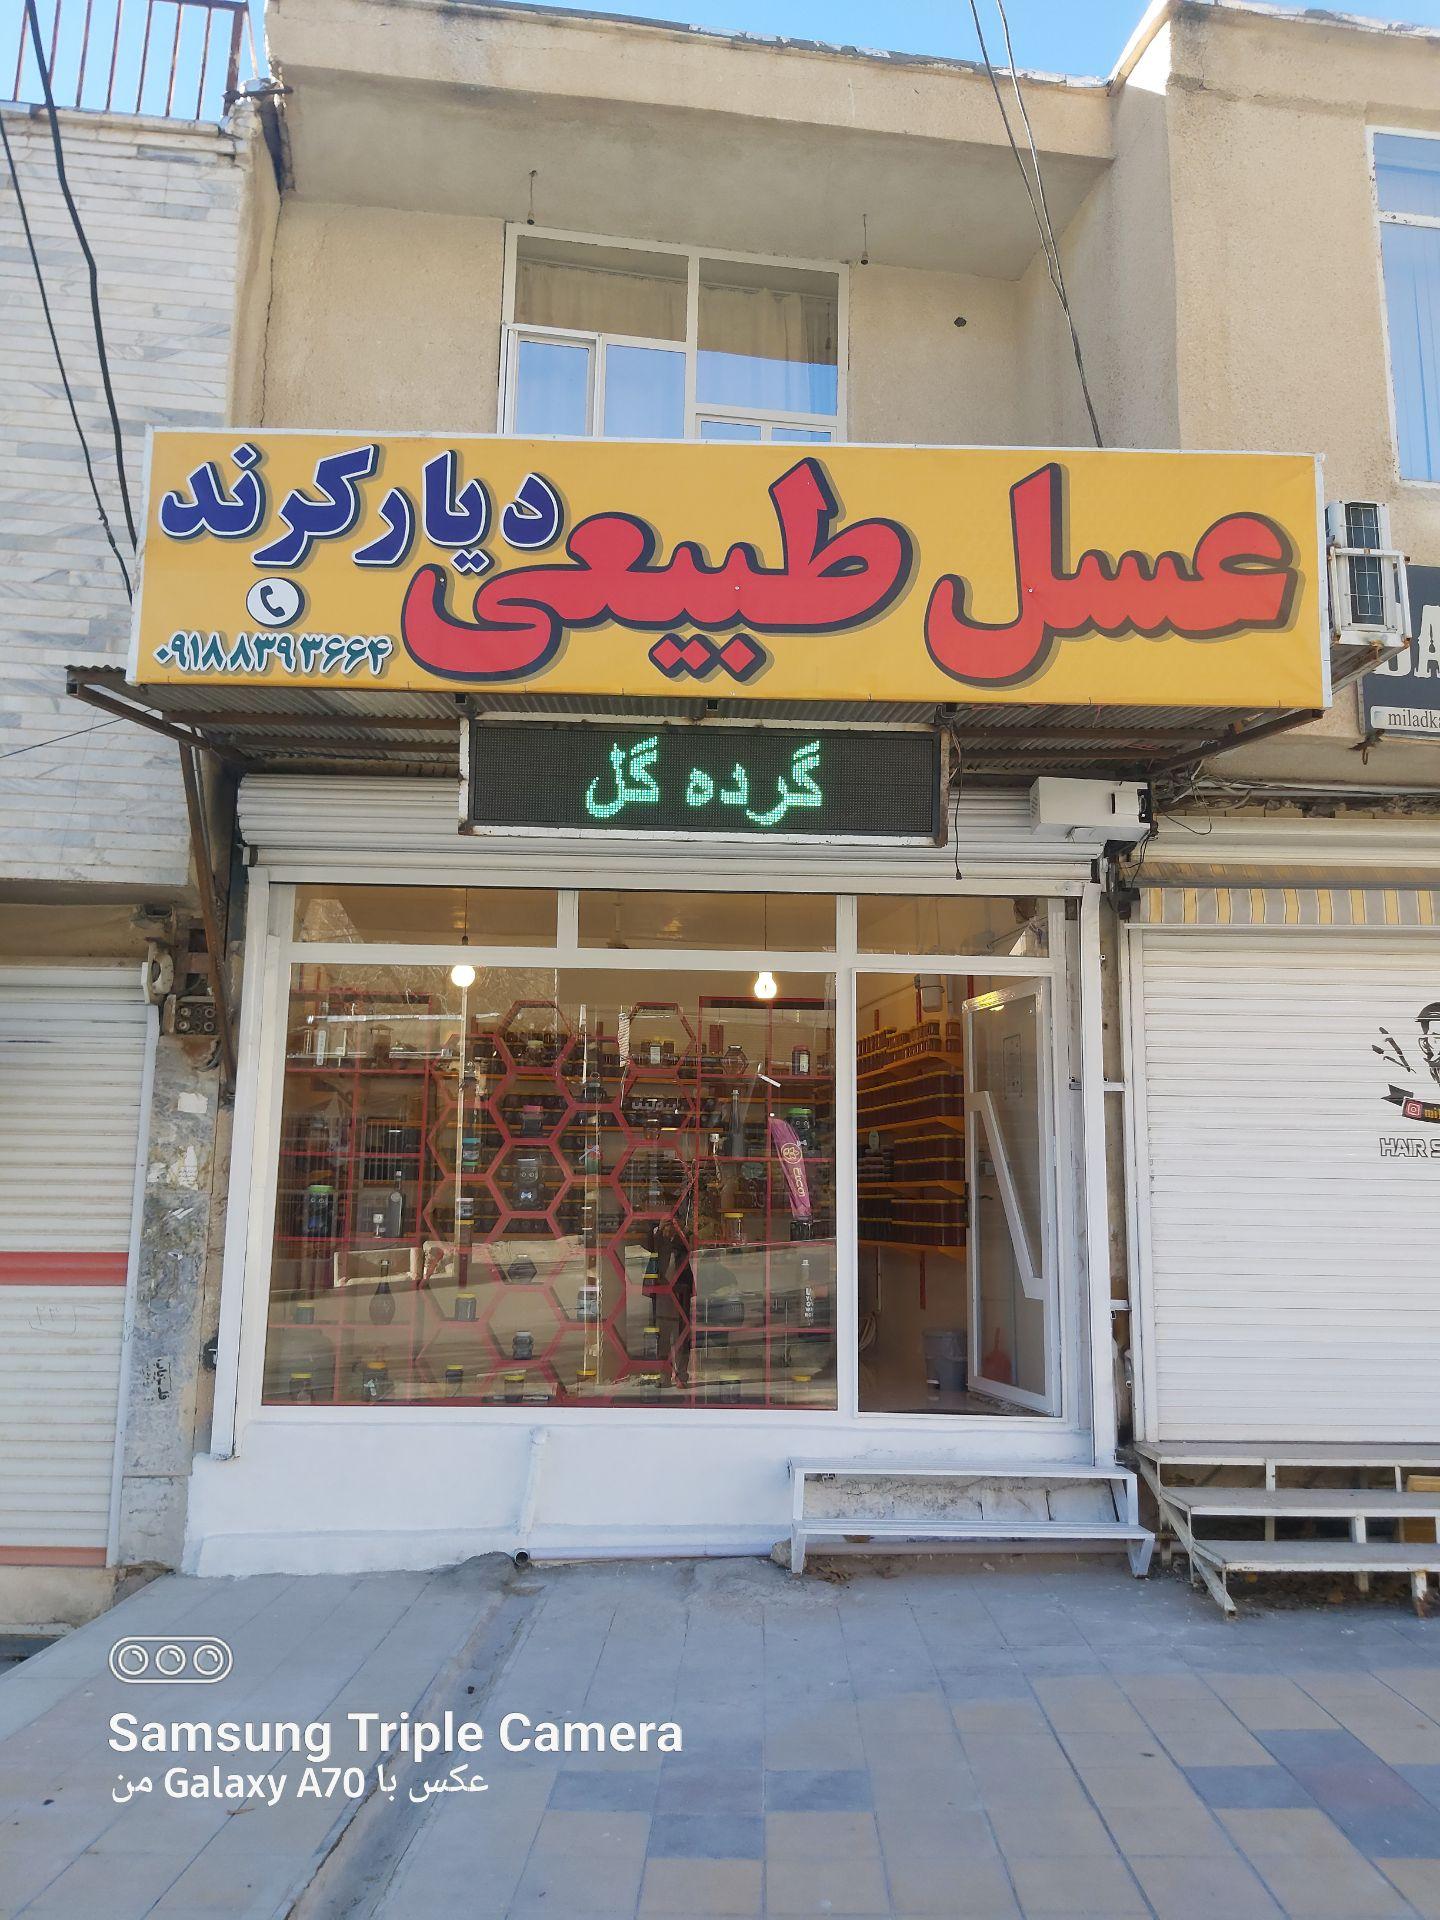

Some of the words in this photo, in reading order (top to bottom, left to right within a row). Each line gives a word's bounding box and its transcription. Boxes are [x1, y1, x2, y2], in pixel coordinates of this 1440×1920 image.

[159, 441, 382, 570] کرند
[351, 448, 566, 576] دیار
[400, 456, 914, 684] طبیعی
[923, 462, 1300, 690] عسل
[585, 735, 660, 819] گل
[1379, 1137, 1428, 1158] HAIR
